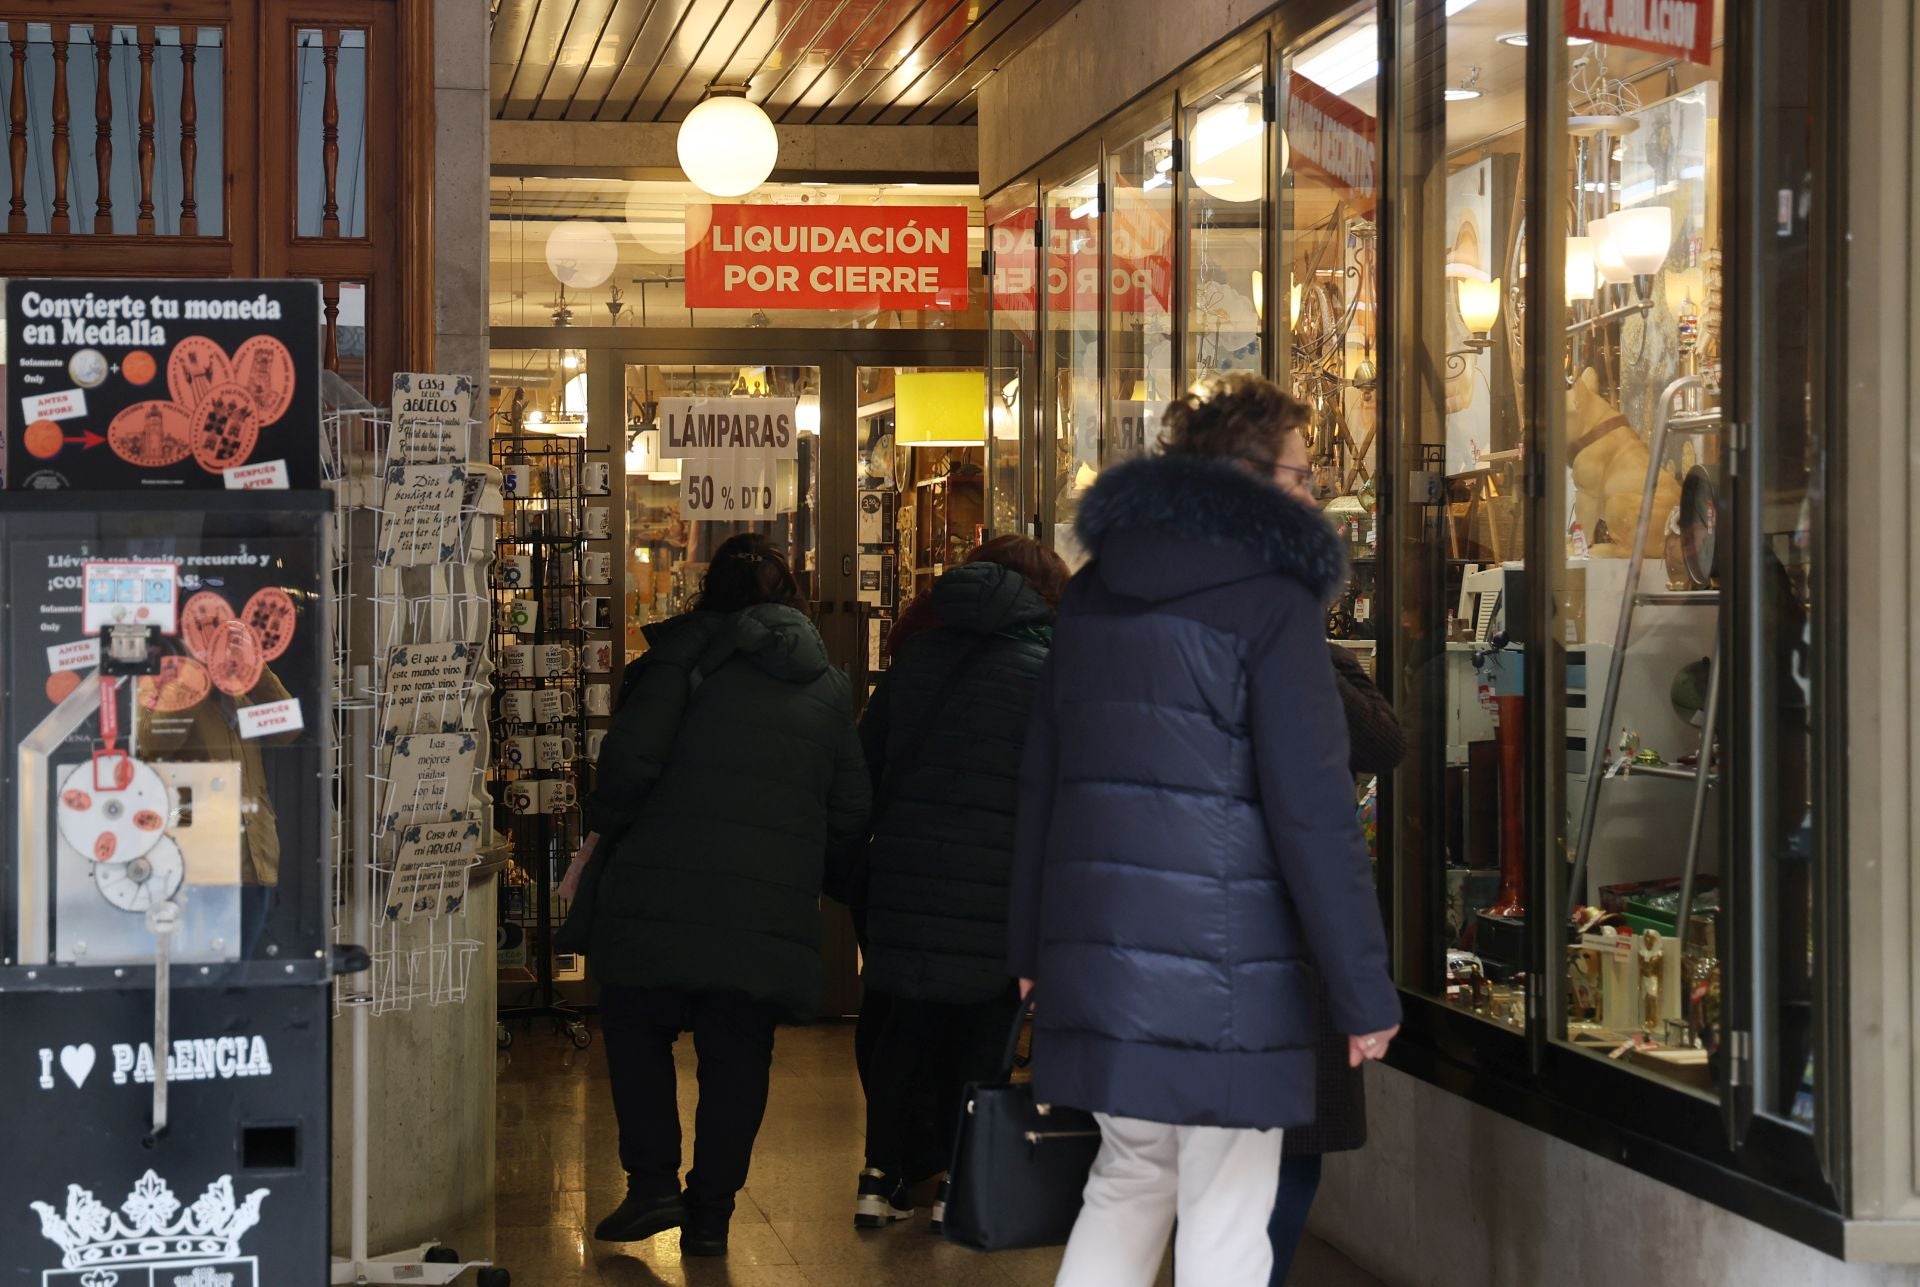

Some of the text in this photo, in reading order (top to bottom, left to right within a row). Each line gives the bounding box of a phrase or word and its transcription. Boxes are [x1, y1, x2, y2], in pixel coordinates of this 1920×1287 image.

[713, 219, 949, 254] LIQUIDACIÓN
[724, 265, 939, 293] POR CIERRE
[21, 291, 281, 319] Convierte tu moneda
[23, 319, 166, 346] en Medalla
[24, 374, 44, 384] Only
[38, 395, 68, 406] ANTES
[37, 405, 73, 417] BEFORE
[669, 406, 790, 448] LÁMPARAS
[412, 475, 440, 488] Dios
[394, 487, 454, 504] bendiga a la
[688, 475, 772, 510] 50 % DTO
[187, 553, 257, 566] recuerdo
[259, 555, 270, 567] y
[40, 623, 61, 632] Only
[59, 644, 91, 655] ANTES
[58, 653, 95, 666] BEFORE
[411, 653, 422, 664] El
[424, 655, 439, 666] que
[392, 671, 408, 679] este
[411, 667, 440, 677] mundo
[392, 685, 400, 695] y
[401, 683, 412, 691] no
[417, 693, 436, 704] oño
[256, 716, 287, 728] AFTER
[429, 738, 446, 749] Las
[418, 755, 451, 770] mejores
[432, 783, 446, 795] las
[426, 828, 458, 840] Casa de
[414, 846, 425, 855] mi
[39, 1049, 54, 1089] I
